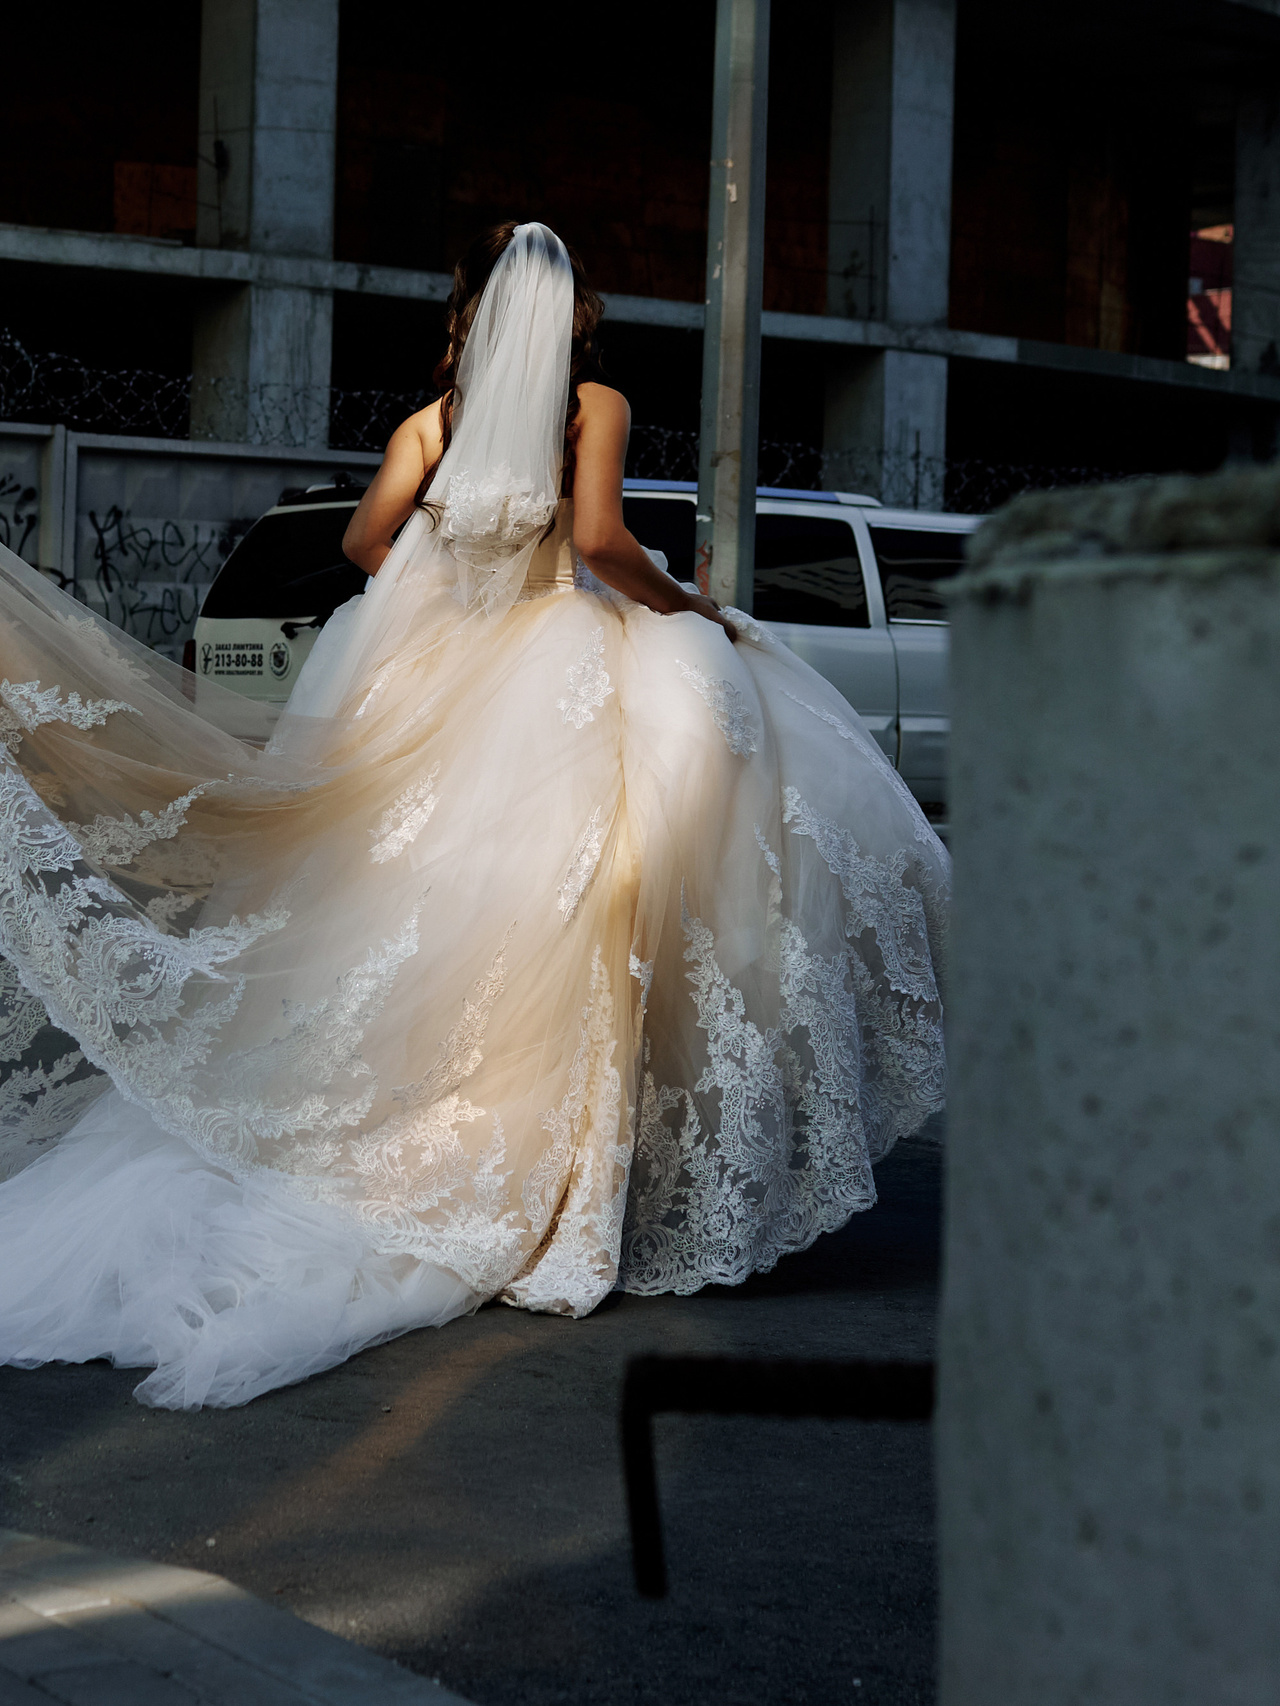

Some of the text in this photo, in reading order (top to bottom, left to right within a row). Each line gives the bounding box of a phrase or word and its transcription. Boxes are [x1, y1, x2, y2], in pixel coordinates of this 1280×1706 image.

[215, 643, 263, 651] ЗАКАЗ ЛИМУЗИНА
[215, 653, 263, 667] 213-80-88
